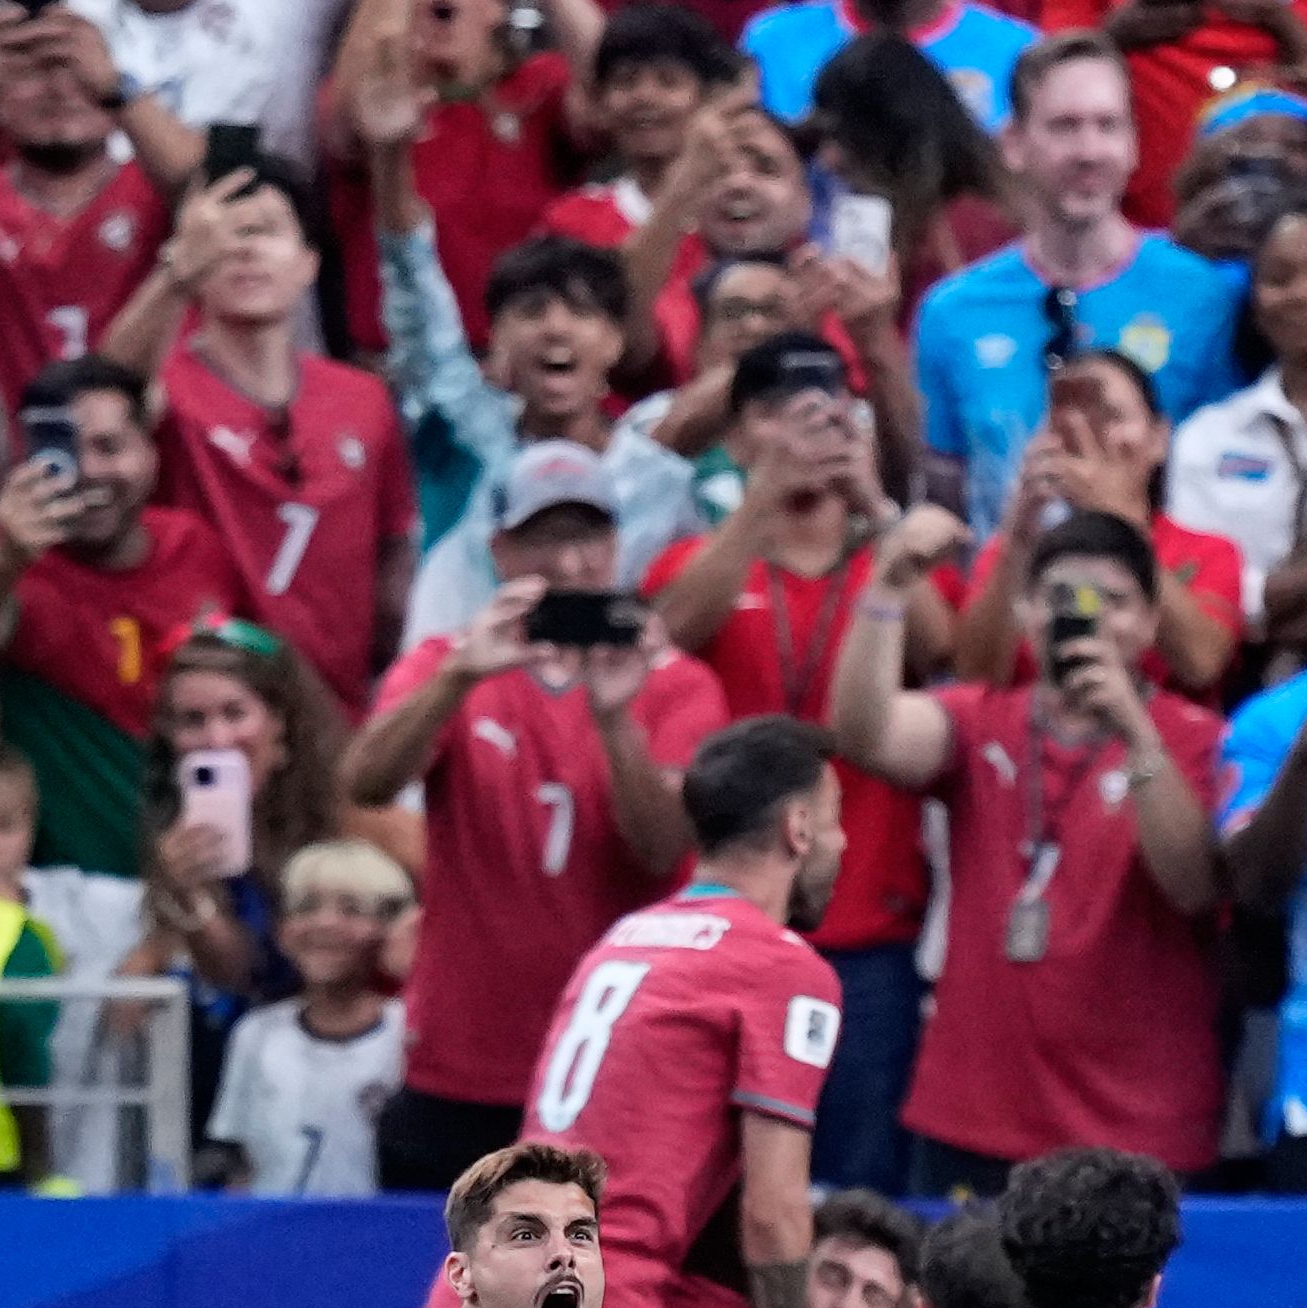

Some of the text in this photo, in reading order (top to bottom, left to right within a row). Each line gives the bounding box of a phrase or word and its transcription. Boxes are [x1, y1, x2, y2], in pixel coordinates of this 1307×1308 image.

[266, 503, 318, 595] 7
[538, 783, 574, 876] 7
[539, 960, 652, 1133] 8
